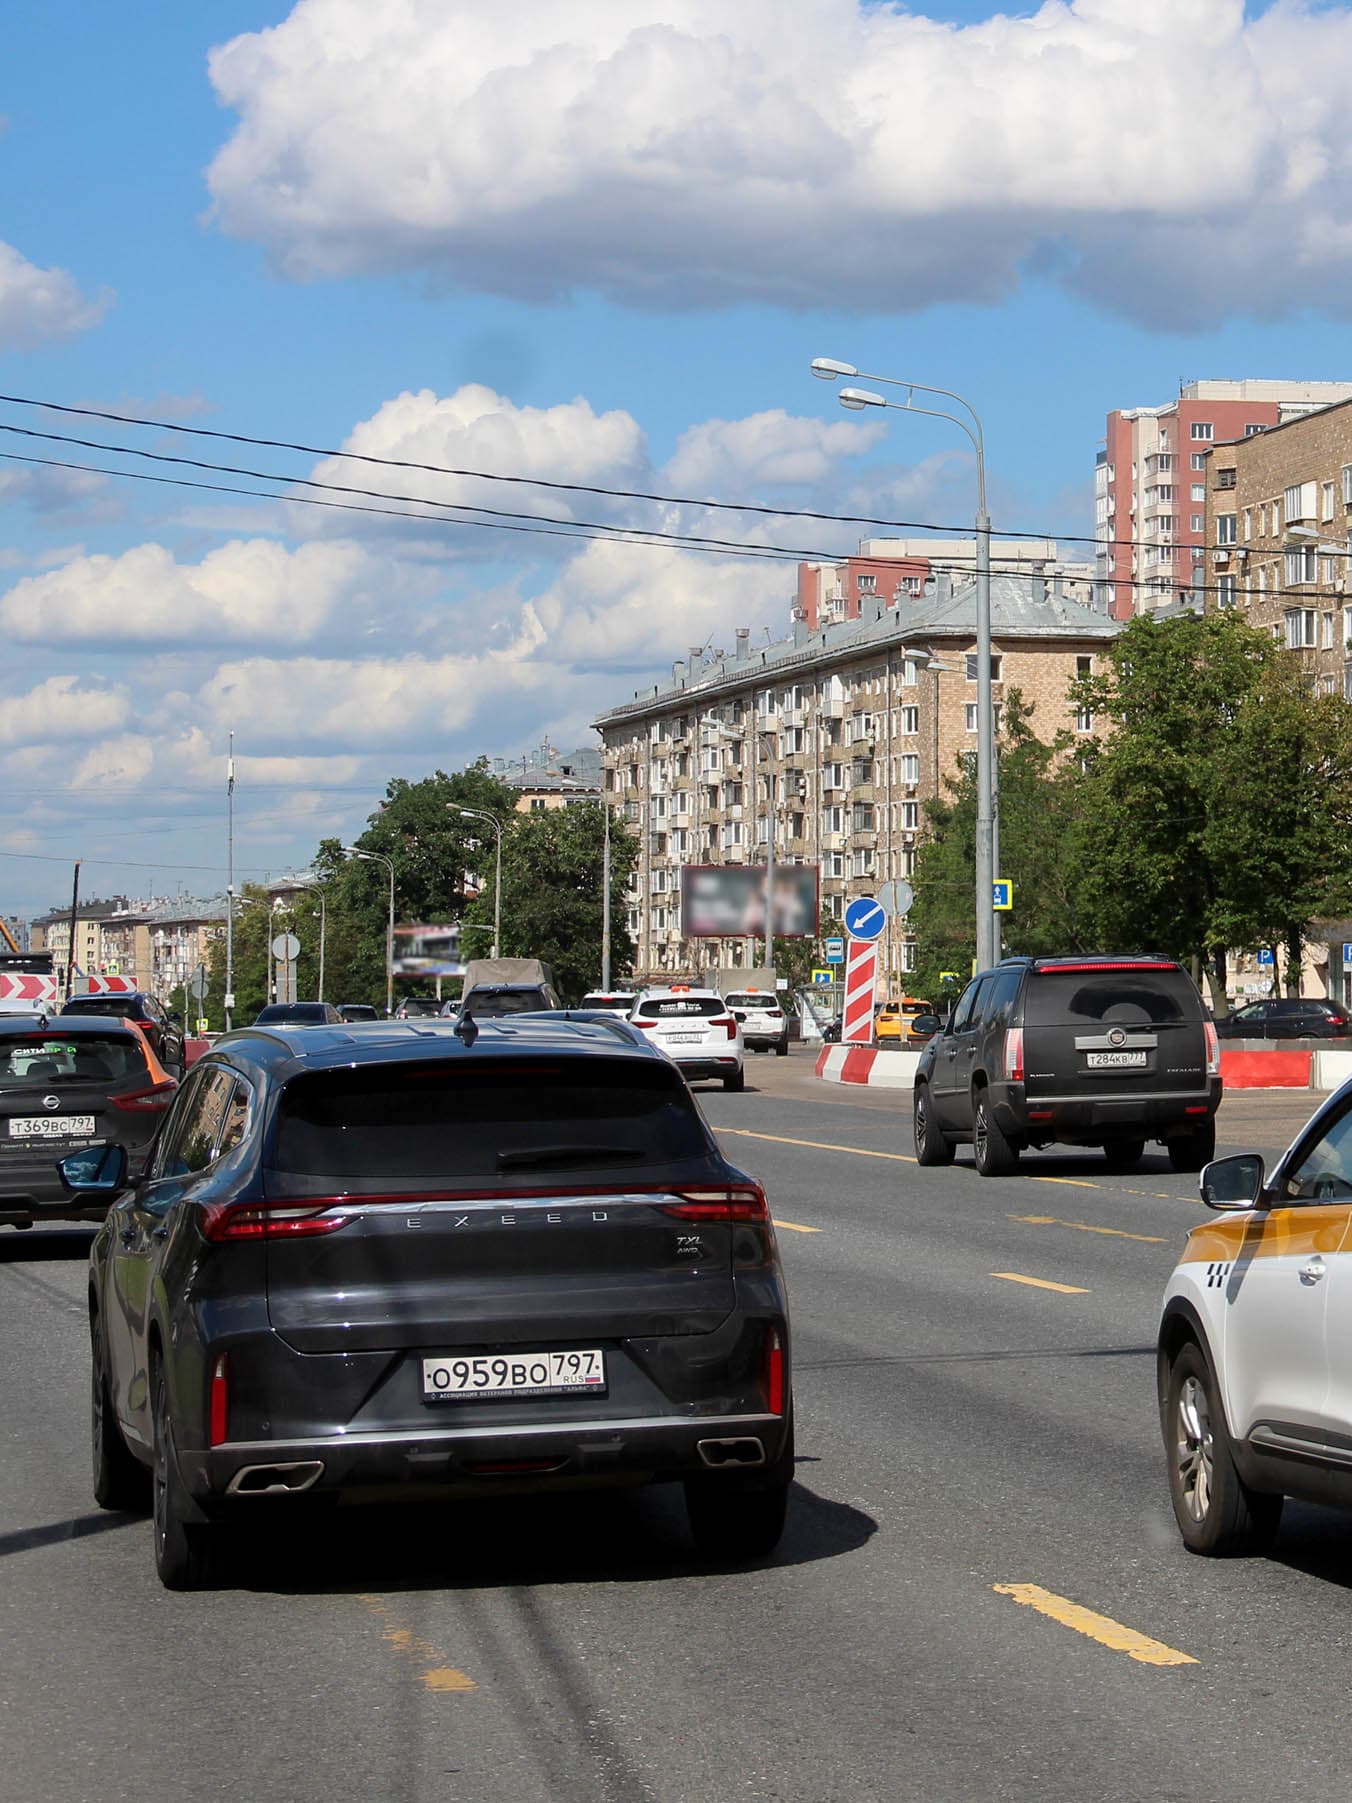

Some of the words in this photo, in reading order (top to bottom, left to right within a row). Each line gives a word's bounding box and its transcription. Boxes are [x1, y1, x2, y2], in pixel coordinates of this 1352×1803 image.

[1090, 1054, 1128, 1065] Т284КВ
[15, 1119, 68, 1133] Т369ВС
[71, 1117, 91, 1128] 797
[407, 1211, 608, 1229] EXEED
[676, 1236, 704, 1246] TXL
[432, 1359, 548, 1389] О959ВО
[552, 1353, 596, 1376] 797
[563, 1375, 584, 1384] RUS
